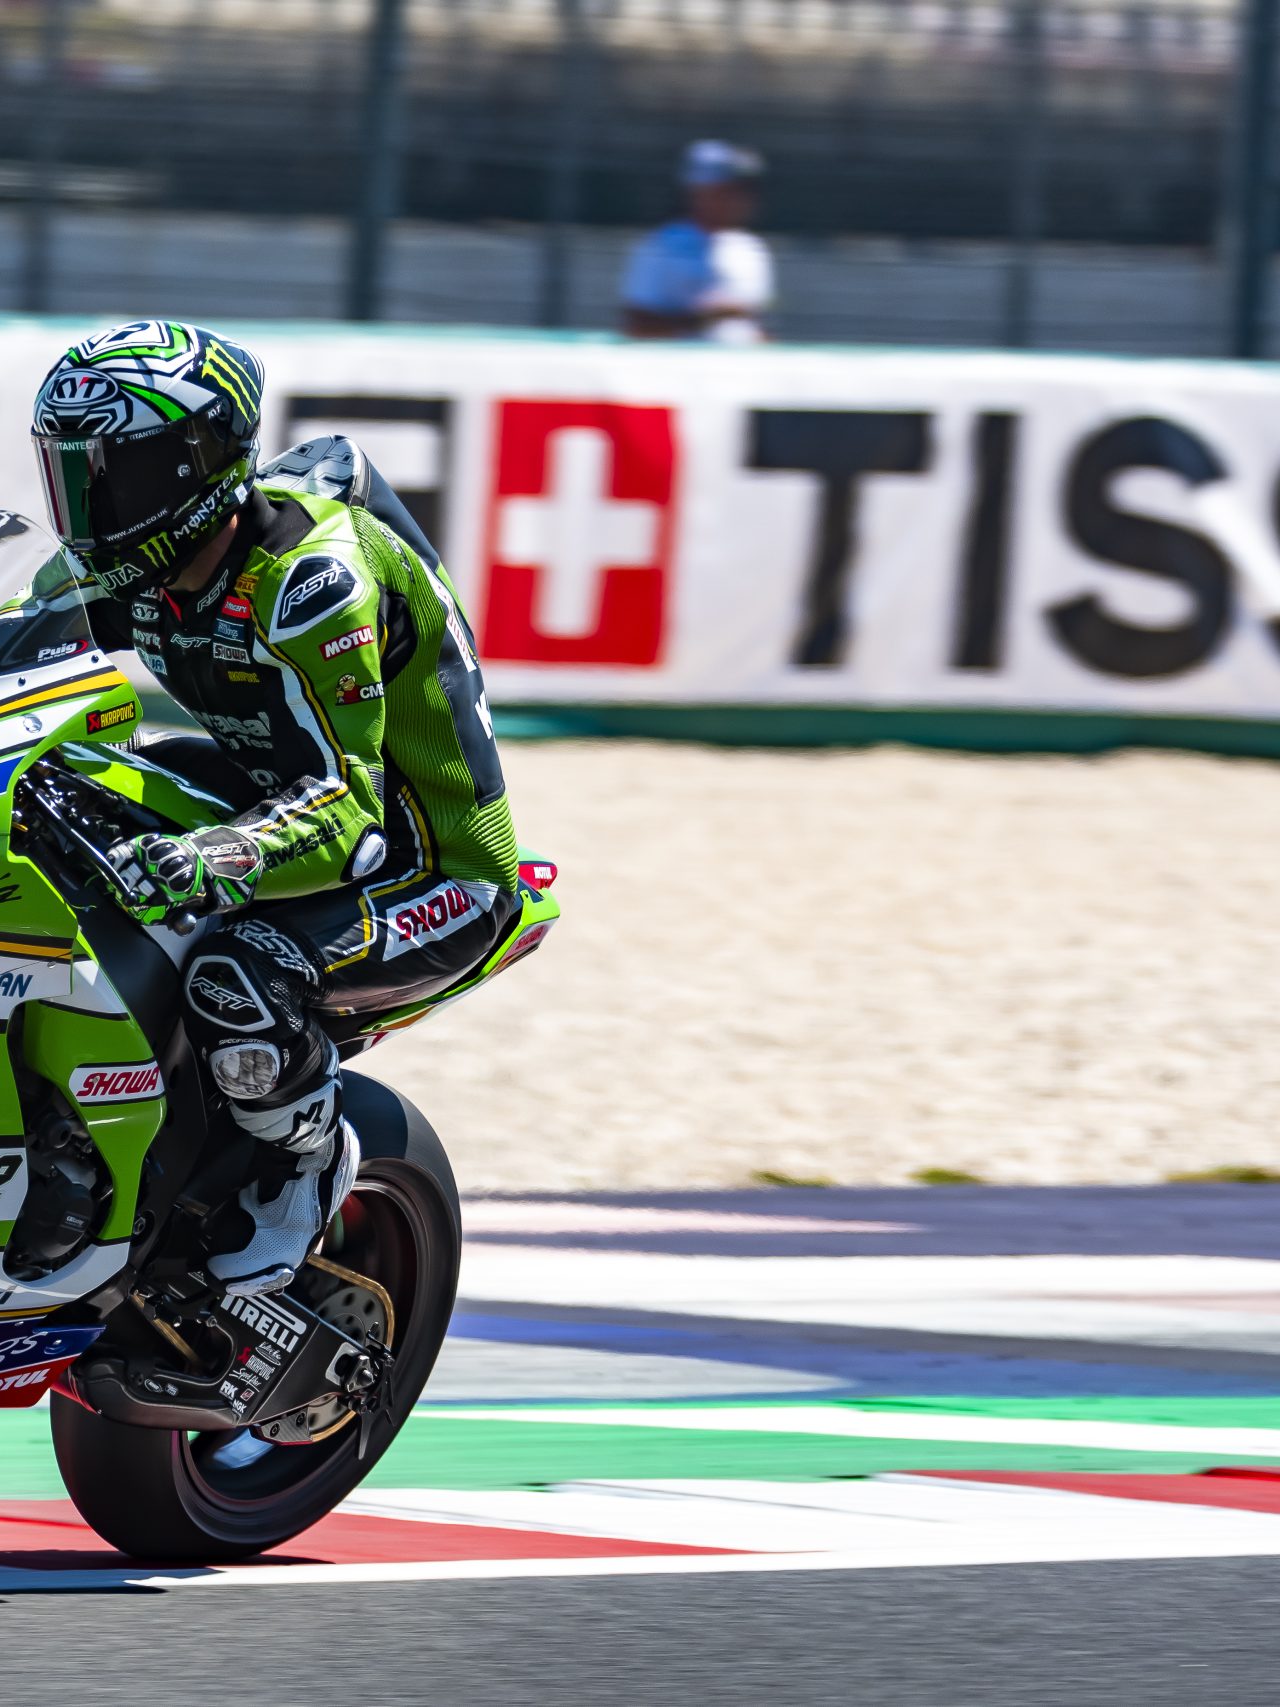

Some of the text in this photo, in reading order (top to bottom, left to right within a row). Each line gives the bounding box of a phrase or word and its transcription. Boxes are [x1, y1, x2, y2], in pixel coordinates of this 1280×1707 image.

[50, 377, 108, 399] KYT
[107, 508, 168, 543] WWW.JUTA.CO.UK
[282, 561, 347, 621] RST
[38, 642, 78, 659] Puig
[170, 633, 212, 649] RST
[324, 627, 374, 658] MOTUL
[202, 842, 251, 857] RST
[263, 813, 345, 872] awasaki
[191, 976, 257, 1010] RST
[76, 1066, 158, 1097] SHOWA
[220, 1293, 308, 1354] PIRELLI
[220, 1380, 239, 1399] RK
[232, 1399, 248, 1415] NGK
